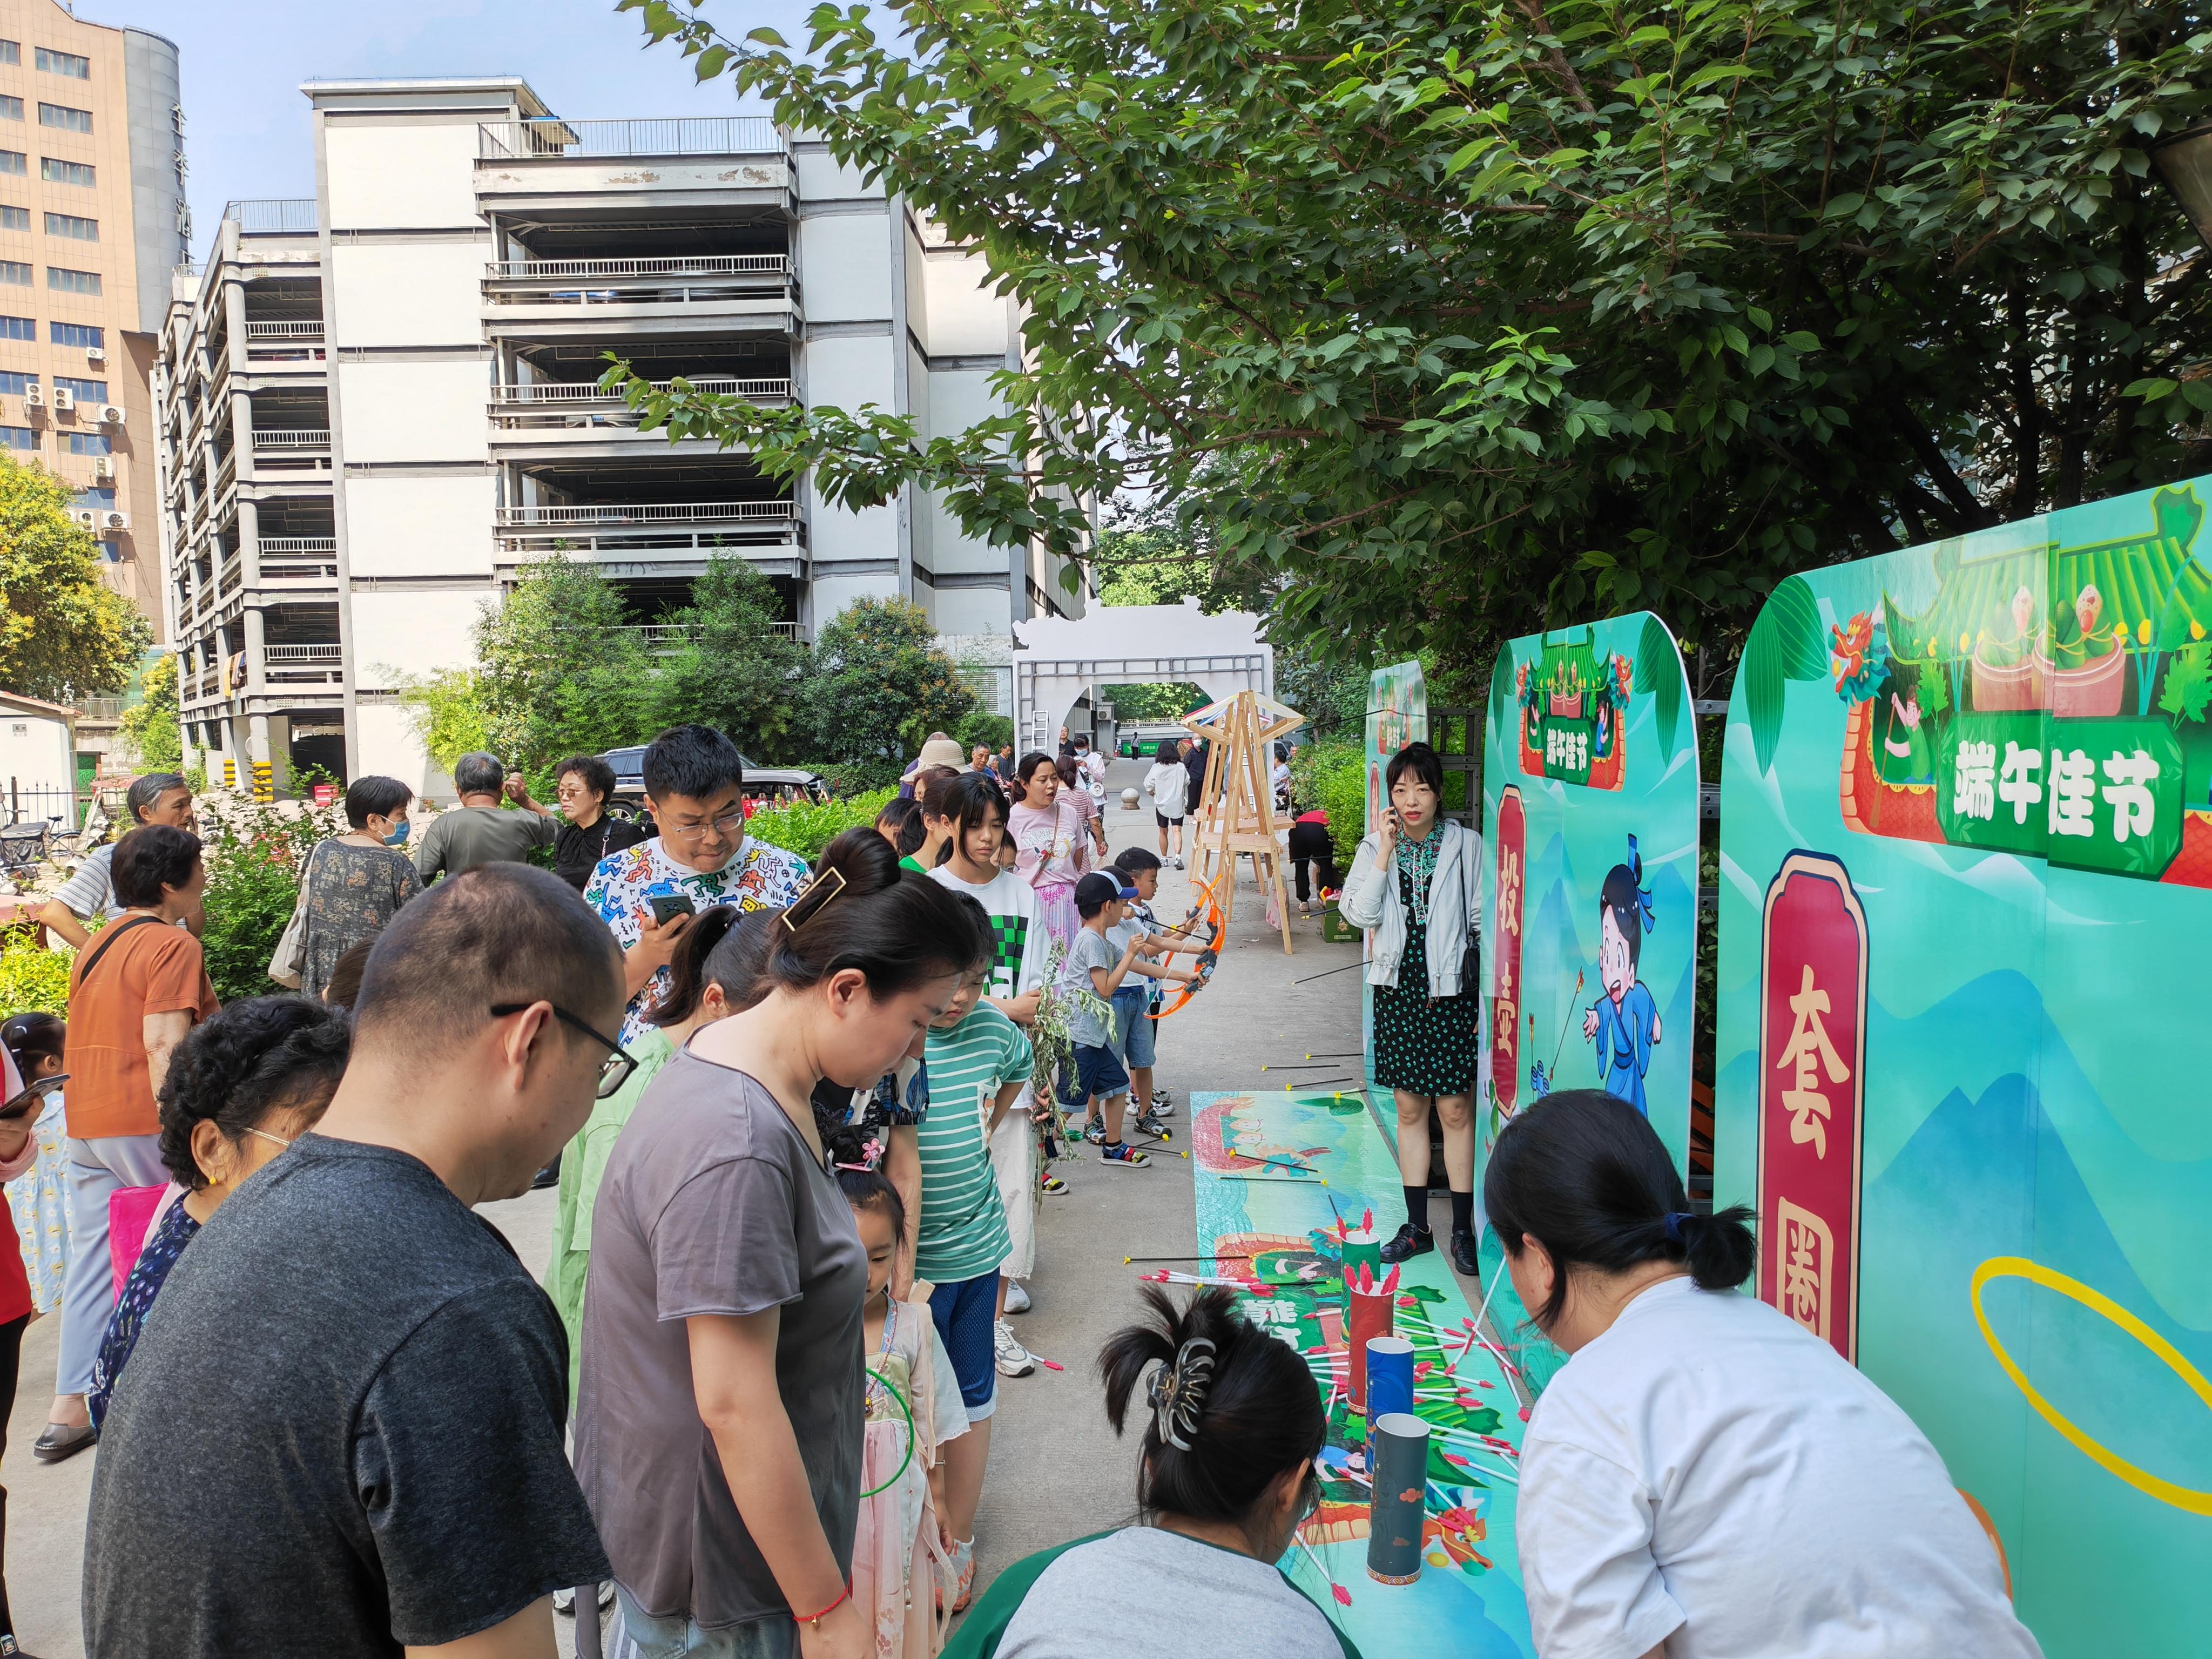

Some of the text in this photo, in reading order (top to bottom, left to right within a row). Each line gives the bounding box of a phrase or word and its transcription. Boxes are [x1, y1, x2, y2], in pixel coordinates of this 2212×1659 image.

[1547, 728, 1588, 772] 端午佳节
[1953, 740, 2160, 843] 端午佳节
[1498, 844, 1519, 1058] 投壶
[1776, 964, 1850, 1344] 套圈
